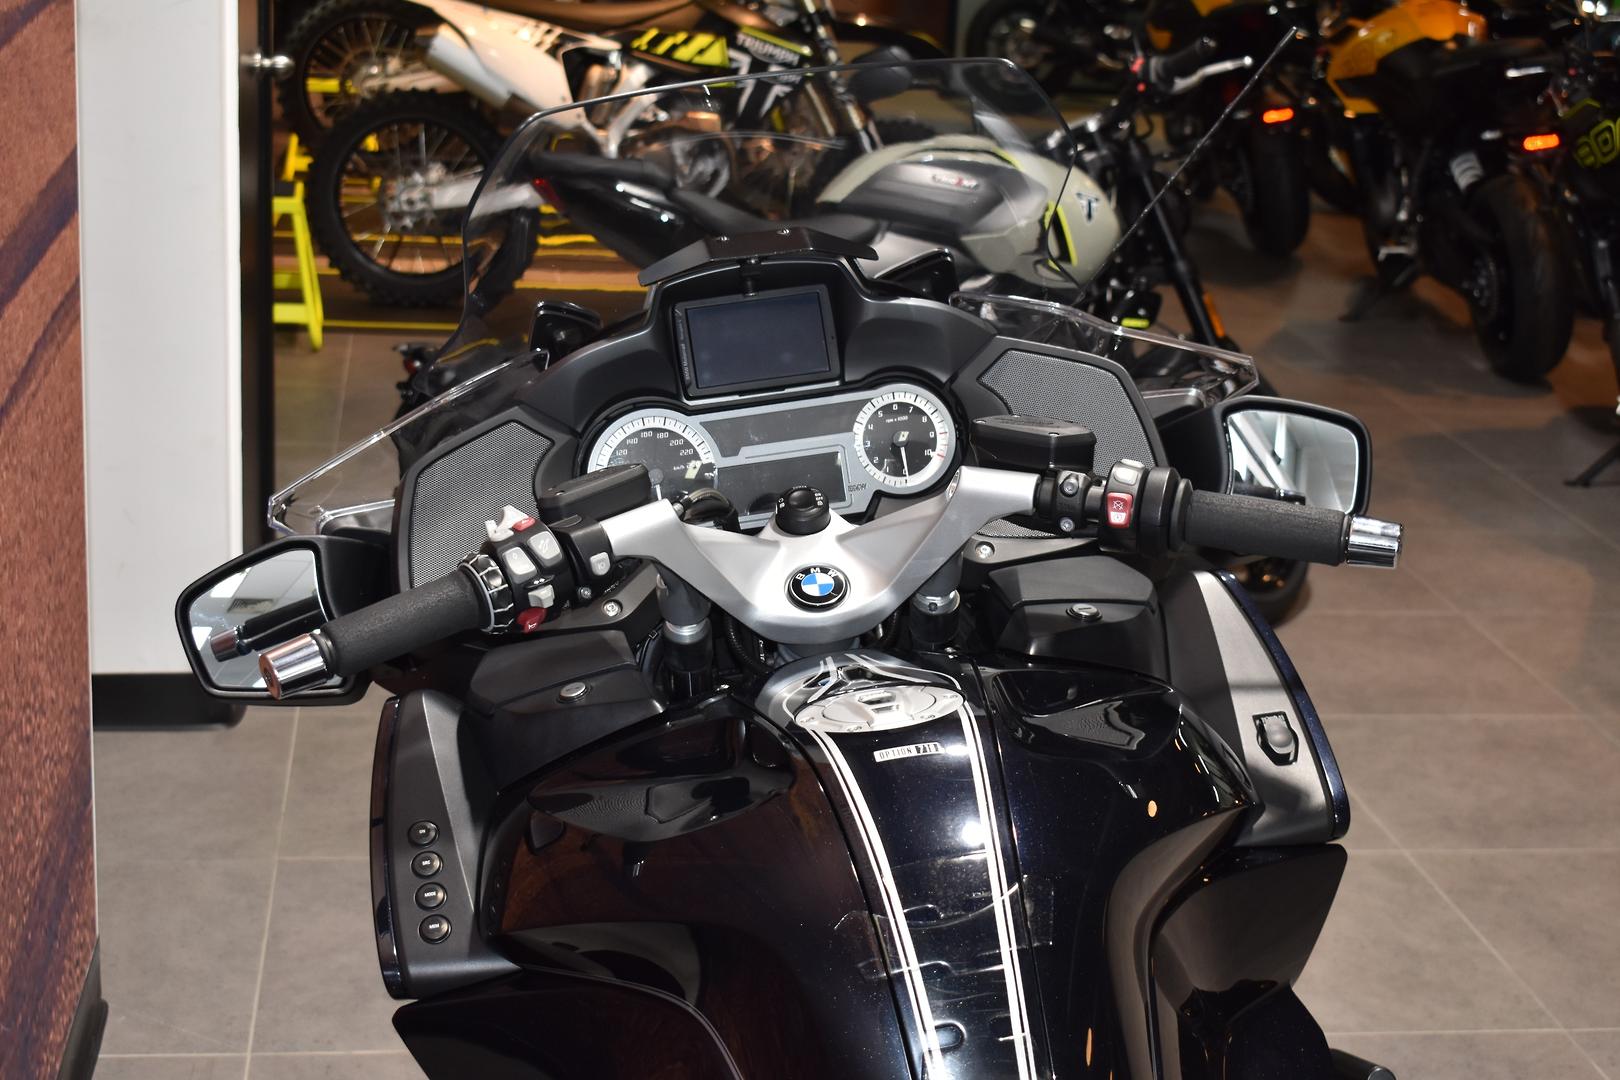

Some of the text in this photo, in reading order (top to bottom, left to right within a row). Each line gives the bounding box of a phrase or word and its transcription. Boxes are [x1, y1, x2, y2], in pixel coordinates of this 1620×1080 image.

[669, 439, 684, 447] 200
[679, 448, 694, 456] 220
[795, 567, 840, 581] BMW
[880, 747, 912, 759] OPTION
